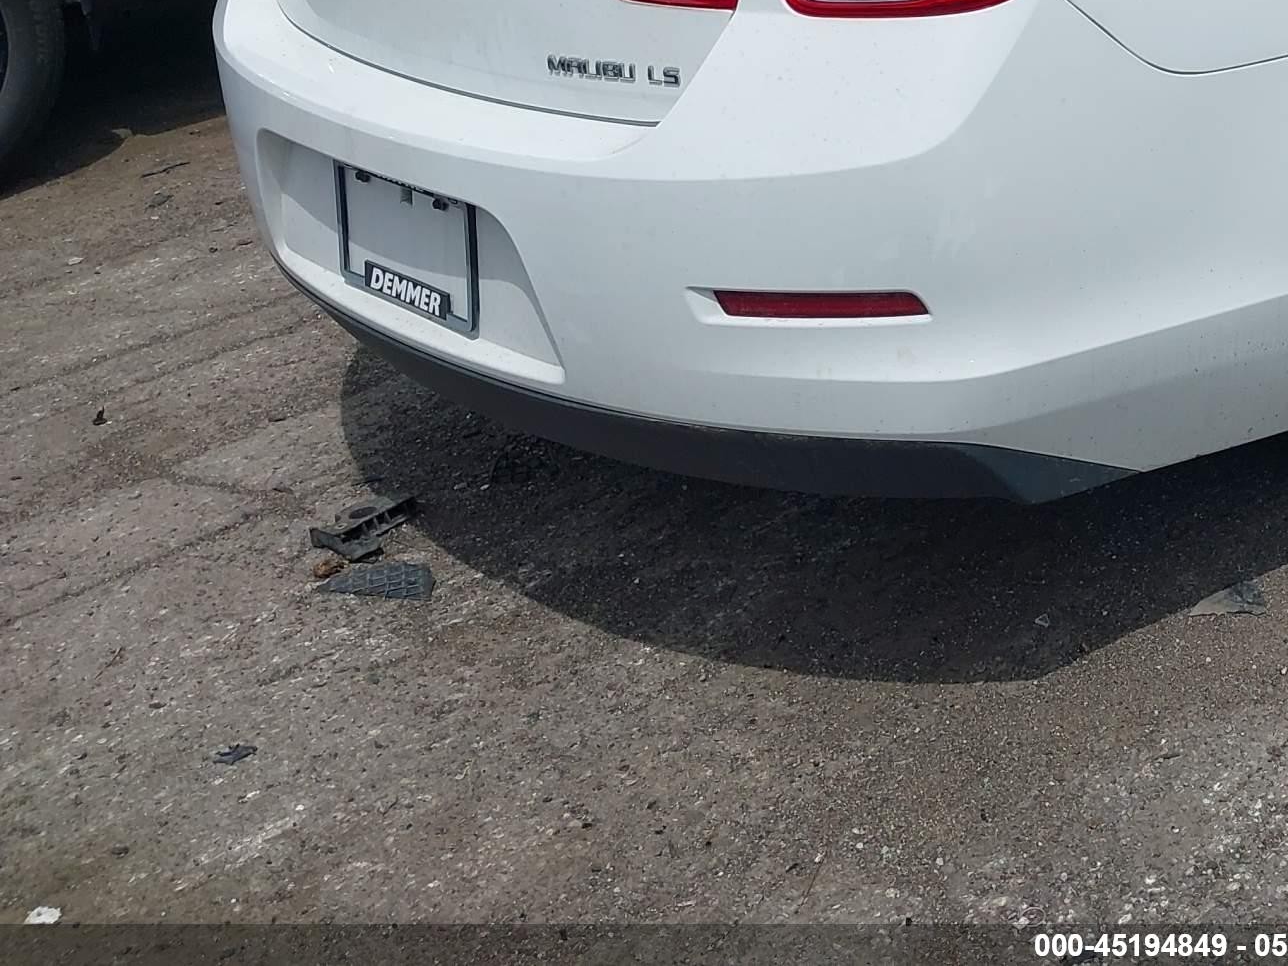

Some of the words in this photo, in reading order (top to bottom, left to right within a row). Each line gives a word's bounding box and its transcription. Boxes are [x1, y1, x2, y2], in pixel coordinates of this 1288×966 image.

[547, 55, 636, 83] MALIBU
[648, 66, 681, 87] LS
[370, 267, 441, 317] DEMMER
